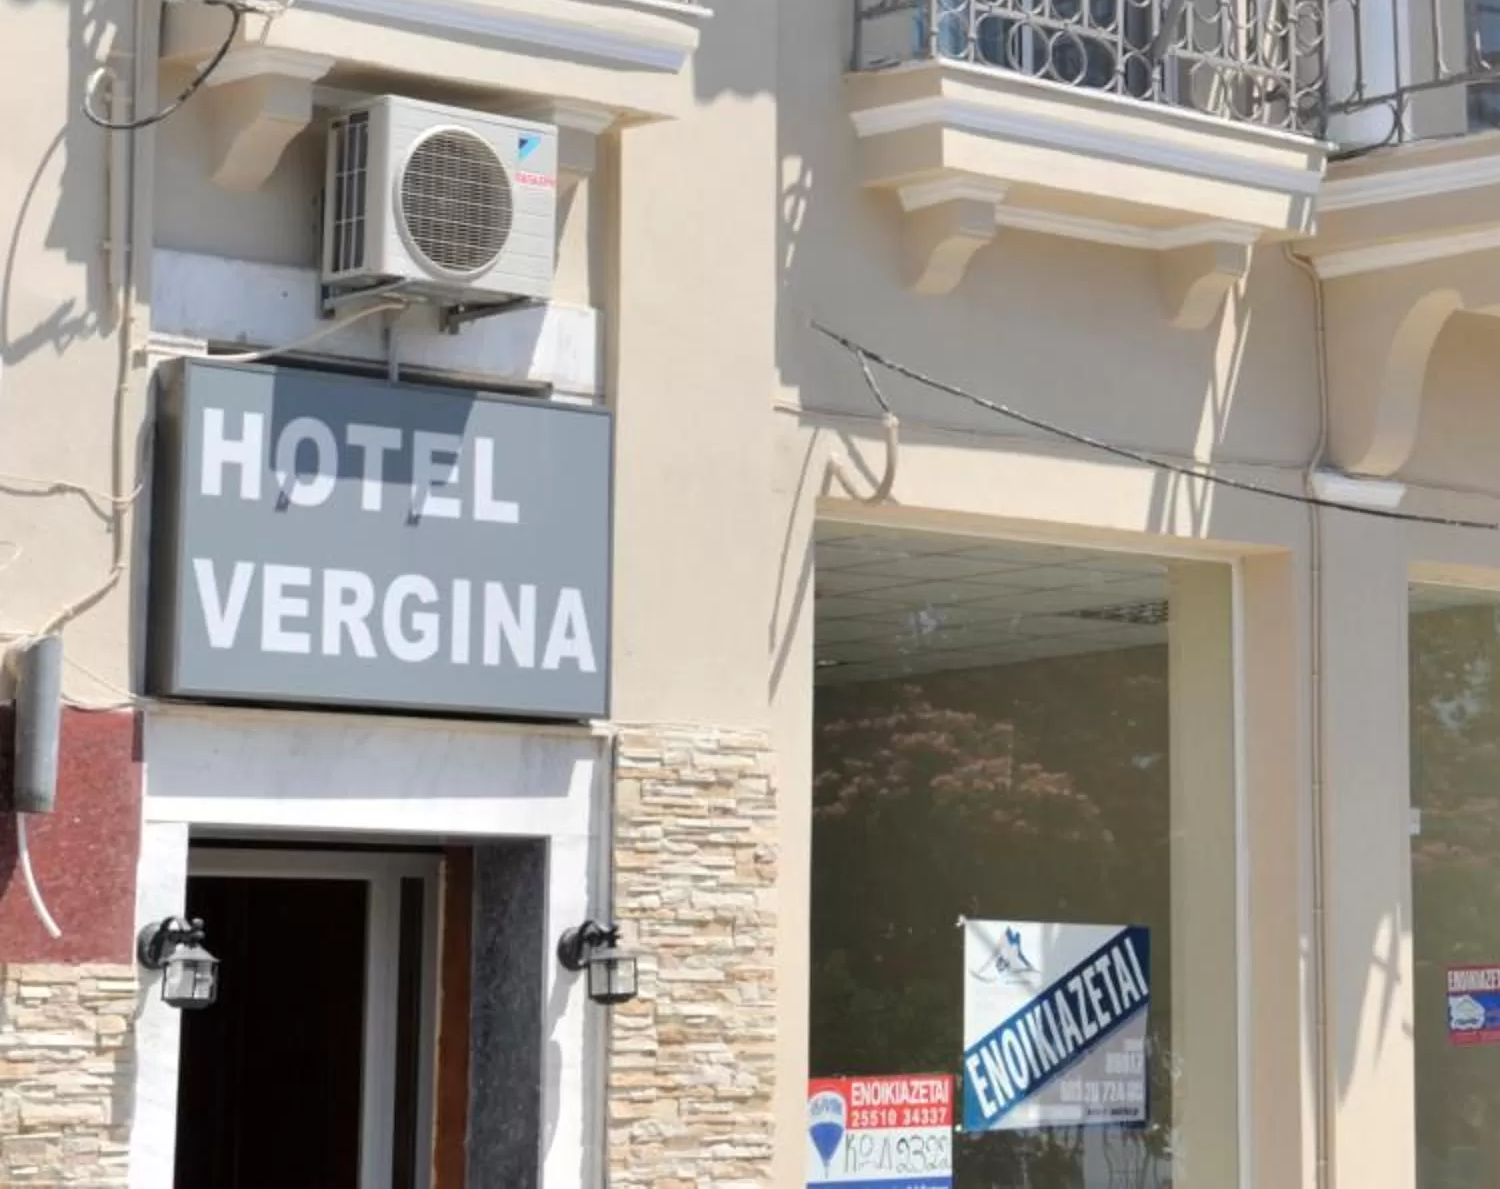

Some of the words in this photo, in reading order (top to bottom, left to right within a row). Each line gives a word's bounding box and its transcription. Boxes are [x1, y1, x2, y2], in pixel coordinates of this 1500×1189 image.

[200, 407, 520, 524] HOTEL
[193, 557, 598, 673] VERGINA
[966, 938, 1149, 1119] ΕΝΟΙΚΙΑΖΕΤΑΙ
[851, 1080, 949, 1106] ΕΝΟΙΚΙΑΖΕΤΑΙ
[851, 1109, 897, 1128] 25510
